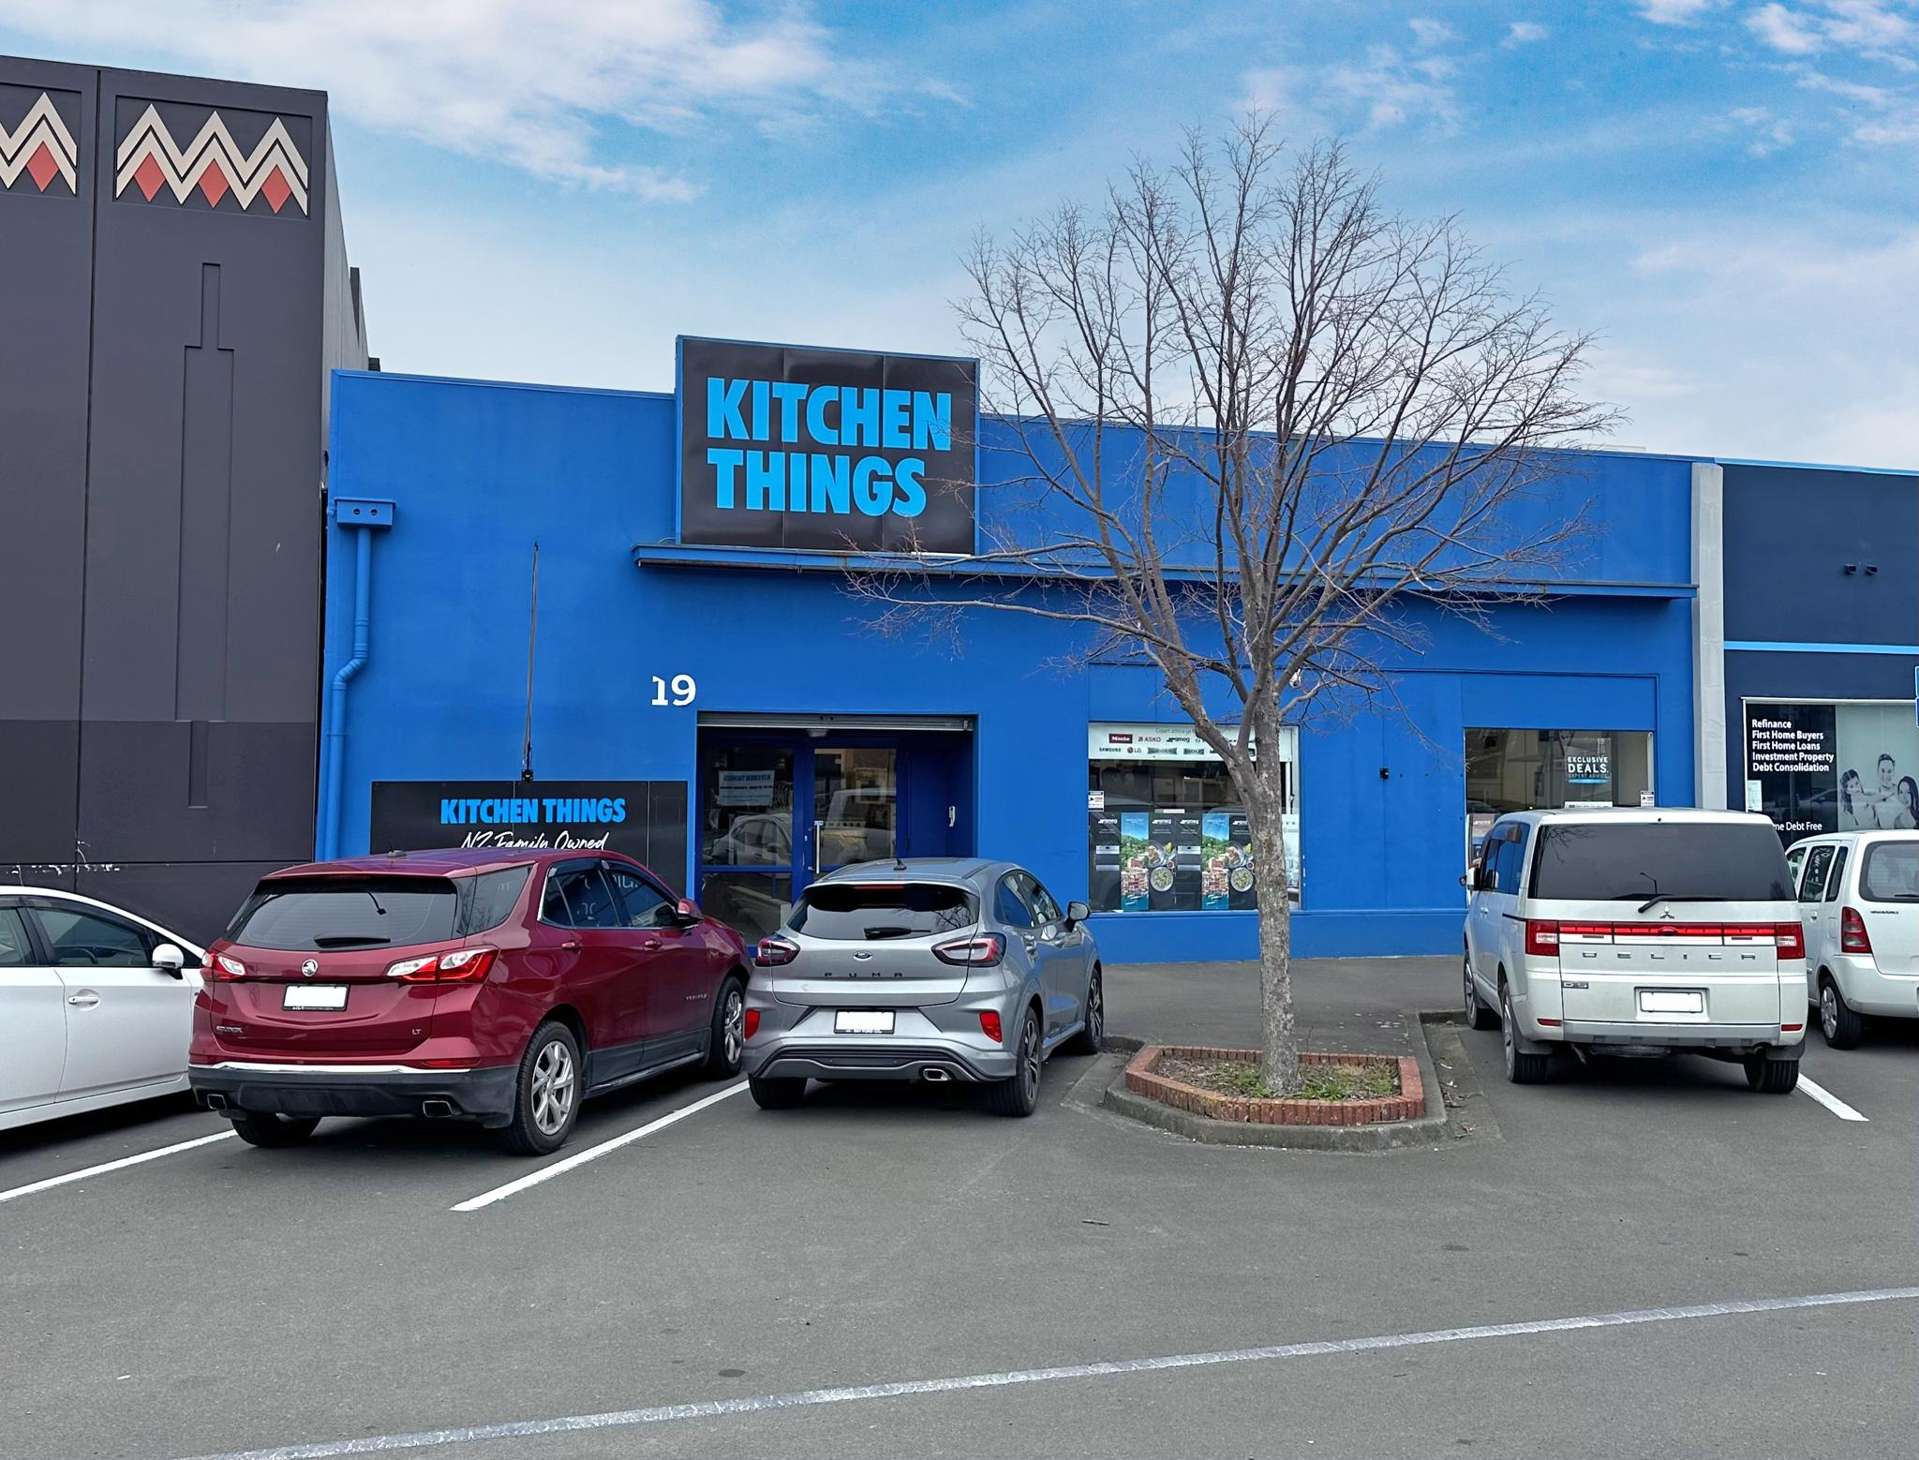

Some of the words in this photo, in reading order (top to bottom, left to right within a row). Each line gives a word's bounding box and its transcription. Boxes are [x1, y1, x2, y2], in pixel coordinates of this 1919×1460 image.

[707, 377, 951, 451] KITCHEN
[707, 448, 927, 518] THINGS
[651, 674, 697, 706] 19
[1752, 719, 1792, 728] Refinance
[1752, 730, 1770, 739] First
[1771, 730, 1796, 739] Home
[1796, 730, 1824, 741] Buyers
[1752, 741, 1770, 750] First
[1771, 741, 1796, 750] Home
[1796, 741, 1821, 750] Loans
[1752, 752, 1798, 761] Investment
[1799, 752, 1834, 763] Property
[1753, 763, 1773, 772] Debt
[1774, 762, 1830, 772] Consolidation
[440, 798, 539, 825] KITCHEN
[543, 798, 626, 824] THINGS
[1785, 821, 1805, 831] Debt
[1806, 821, 1823, 831] Free
[461, 831, 493, 848] NZ
[493, 830, 549, 848] Family
[554, 830, 609, 850] Owned
